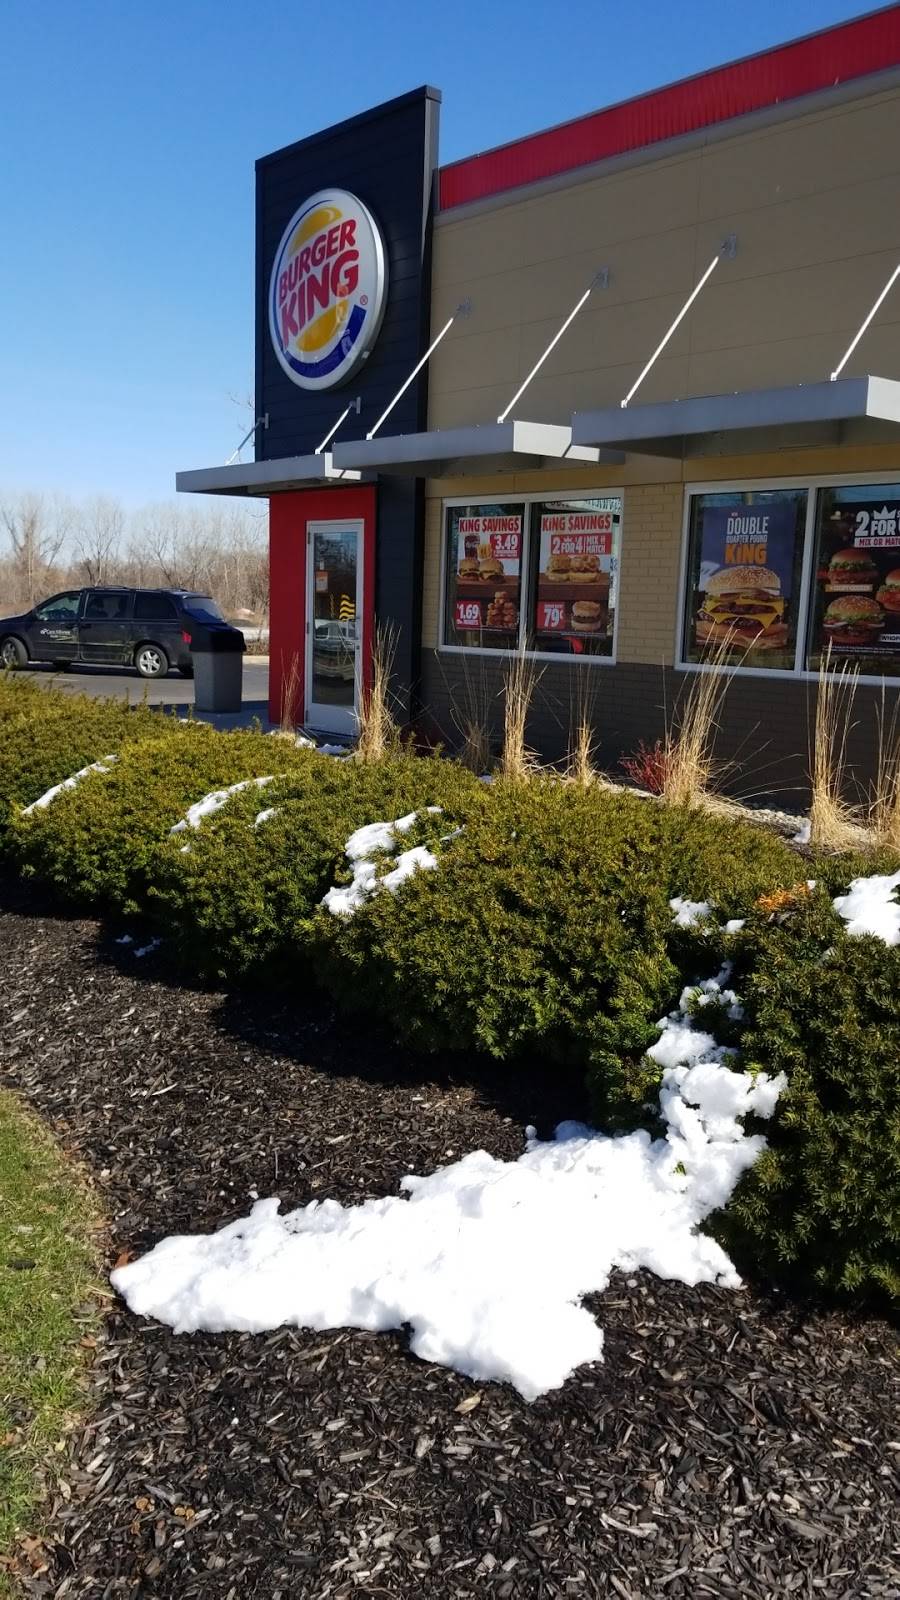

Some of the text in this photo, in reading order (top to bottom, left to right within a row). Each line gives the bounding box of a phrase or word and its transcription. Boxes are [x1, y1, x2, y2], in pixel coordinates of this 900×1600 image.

[278, 219, 356, 306] BURGER
[279, 249, 359, 348] KING
[460, 518, 480, 532] KING
[542, 516, 566, 531] KING
[727, 516, 769, 535] DOUBLE
[855, 511, 870, 536] 2
[871, 520, 897, 536] FOR
[552, 536, 561, 554] 2
[725, 543, 767, 564] KING
